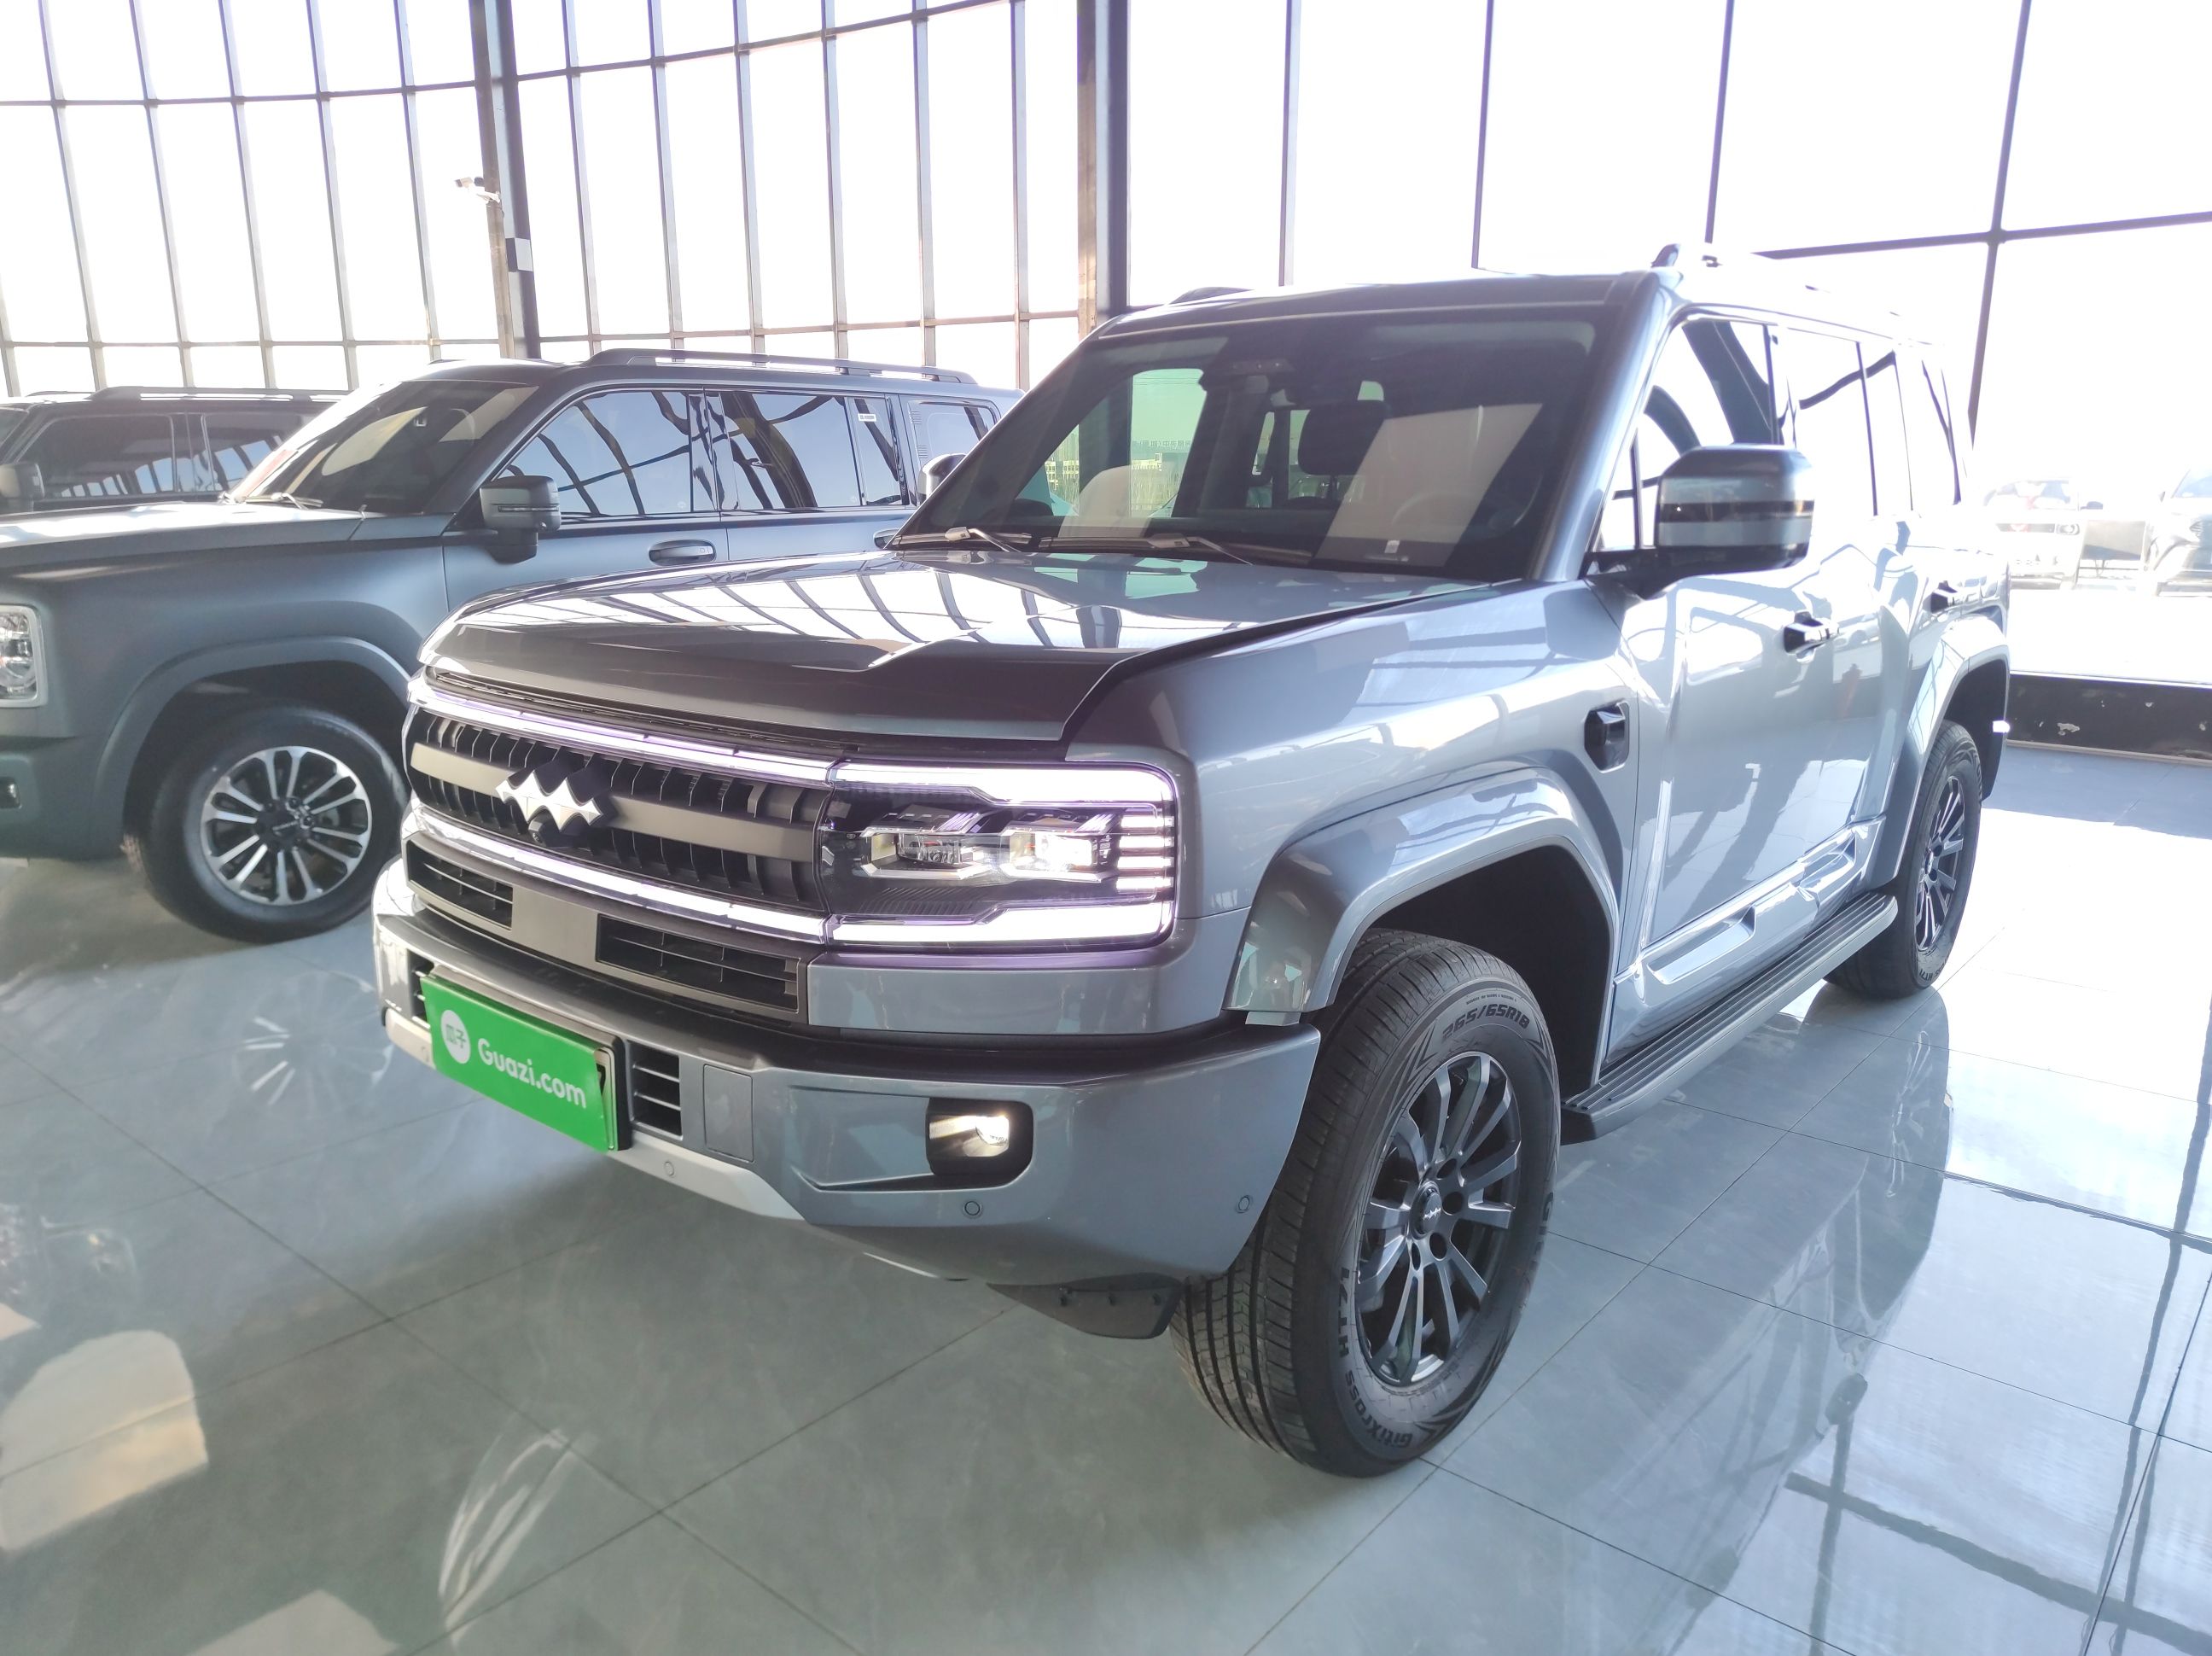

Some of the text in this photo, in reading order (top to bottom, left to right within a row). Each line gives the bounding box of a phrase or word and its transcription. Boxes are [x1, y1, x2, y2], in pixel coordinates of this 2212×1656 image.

[444, 1023, 467, 1049] 瓜子
[1442, 1003, 1530, 1037] 265/65R18
[478, 1038, 587, 1109] Guazi.com
[1338, 1268, 1349, 1358] HT71
